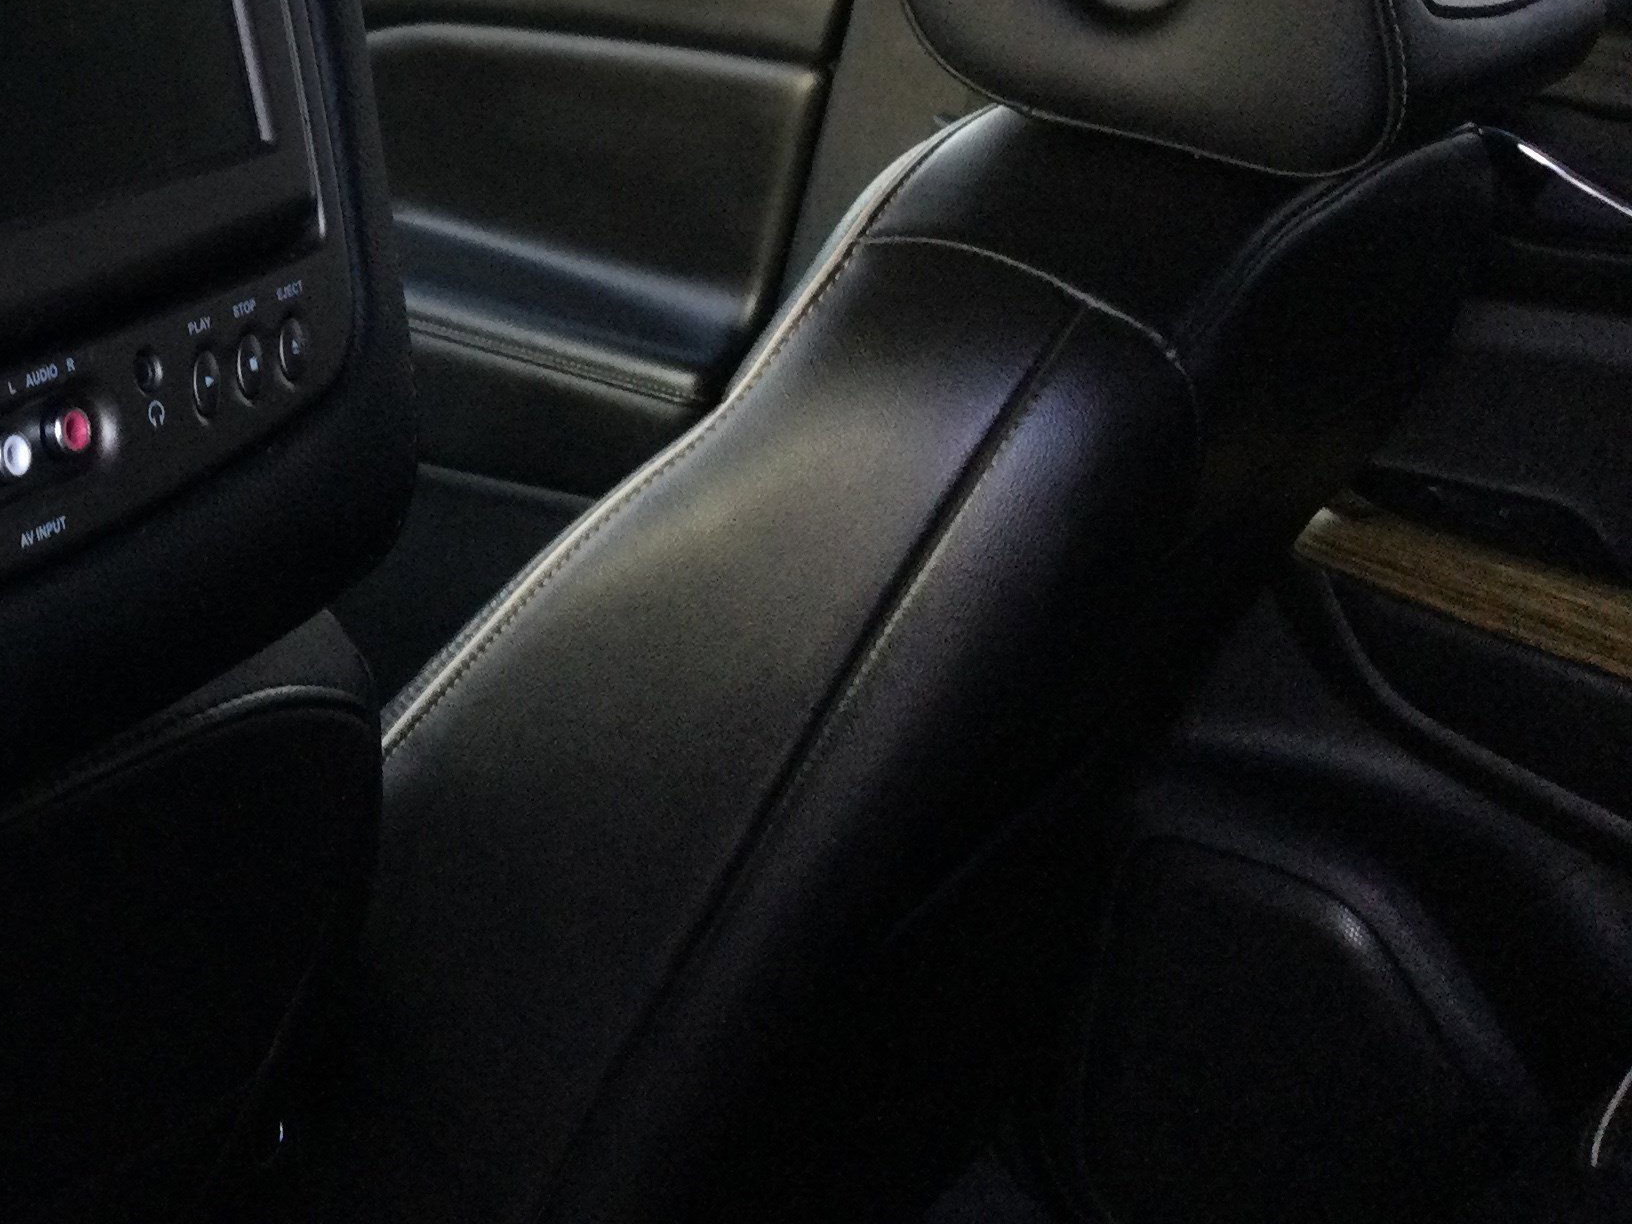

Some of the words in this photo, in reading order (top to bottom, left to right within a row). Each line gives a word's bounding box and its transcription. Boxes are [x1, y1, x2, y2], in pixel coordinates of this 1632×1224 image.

[276, 280, 303, 301] EJECT
[232, 298, 256, 318] STOP
[187, 316, 211, 336] PLAY
[8, 381, 17, 395] L
[25, 363, 58, 388] AUDIO
[66, 357, 76, 372] R
[20, 530, 34, 549] AV
[35, 515, 67, 542] INPUT
